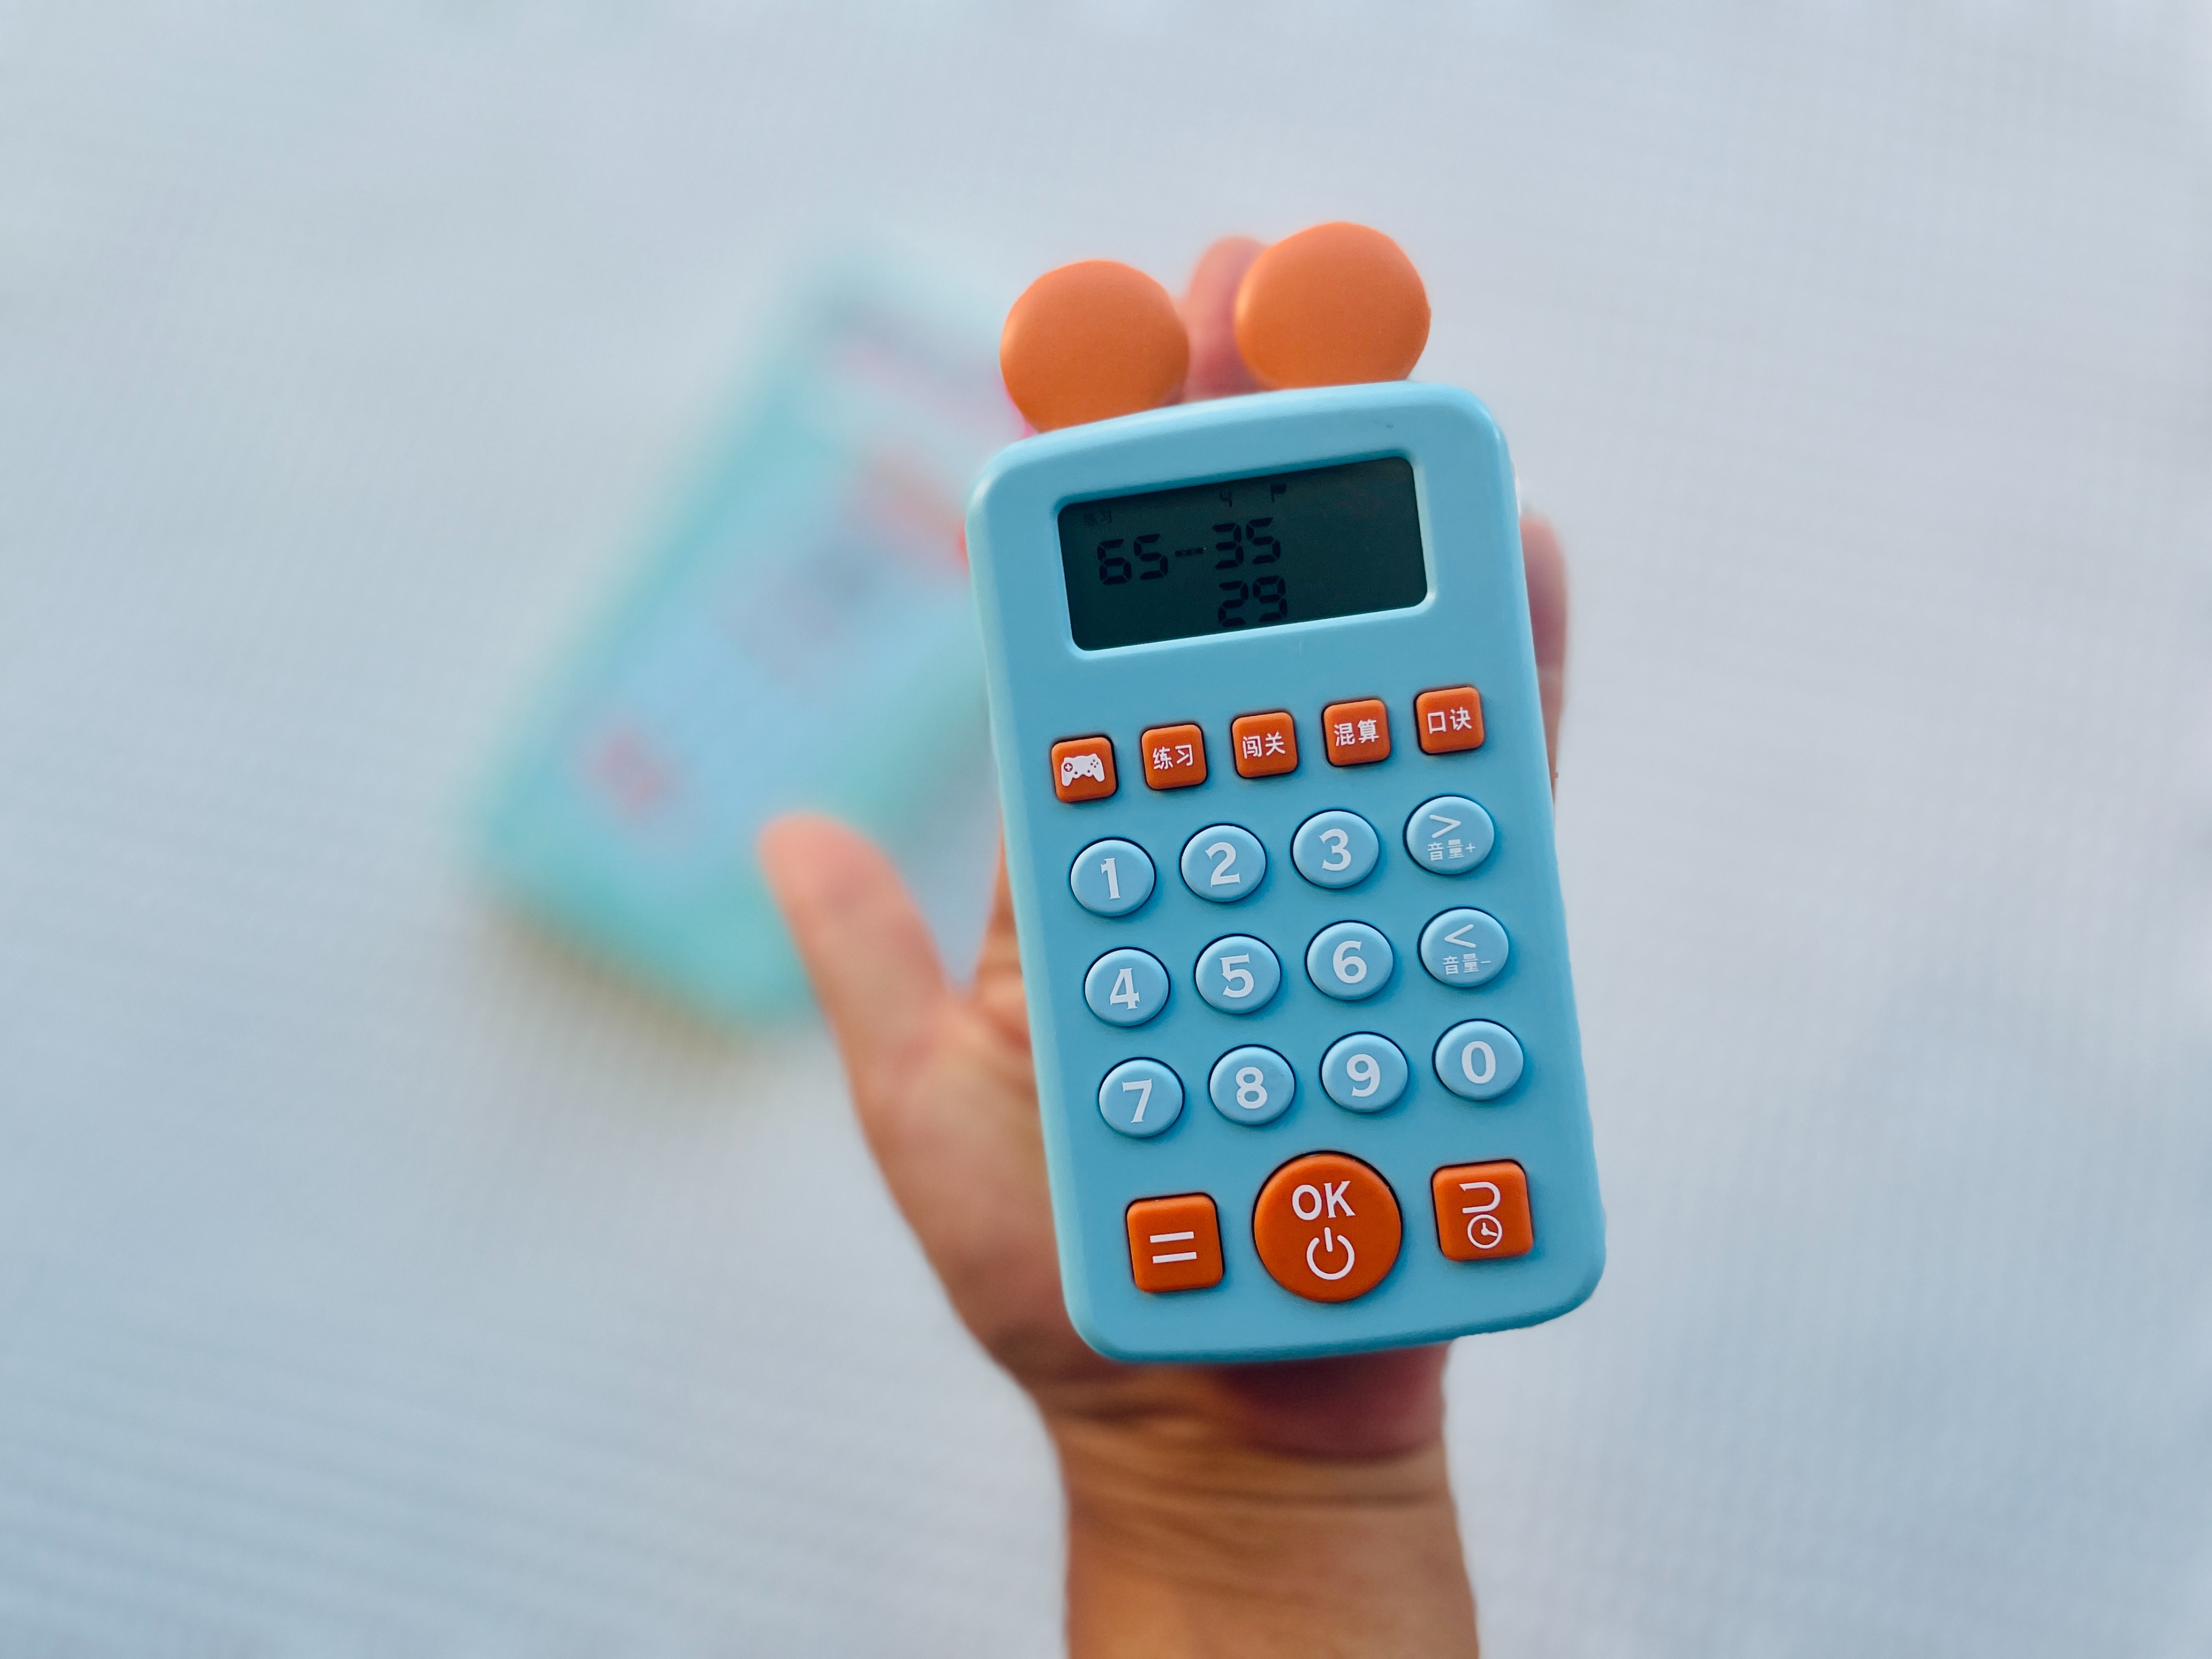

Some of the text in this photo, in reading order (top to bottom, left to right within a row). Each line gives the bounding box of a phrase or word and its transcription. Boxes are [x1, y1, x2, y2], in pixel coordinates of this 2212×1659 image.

[1218, 574, 1289, 627] 29
[1333, 719, 1380, 747] 混算
[1427, 706, 1472, 735] 口诀
[1151, 744, 1194, 771] 练习
[1241, 732, 1286, 760] 闯关
[1205, 842, 1240, 887] 2
[1318, 828, 1352, 872] 3
[1100, 857, 1121, 900] 1
[1219, 953, 1255, 998] 5
[1332, 940, 1368, 985] 6
[1109, 968, 1141, 1010] 4
[1346, 1054, 1381, 1098] 9
[1461, 1041, 1497, 1085] 0
[1122, 1079, 1153, 1124] 7
[1235, 1067, 1269, 1110] 8
[1291, 1180, 1357, 1222] OK
